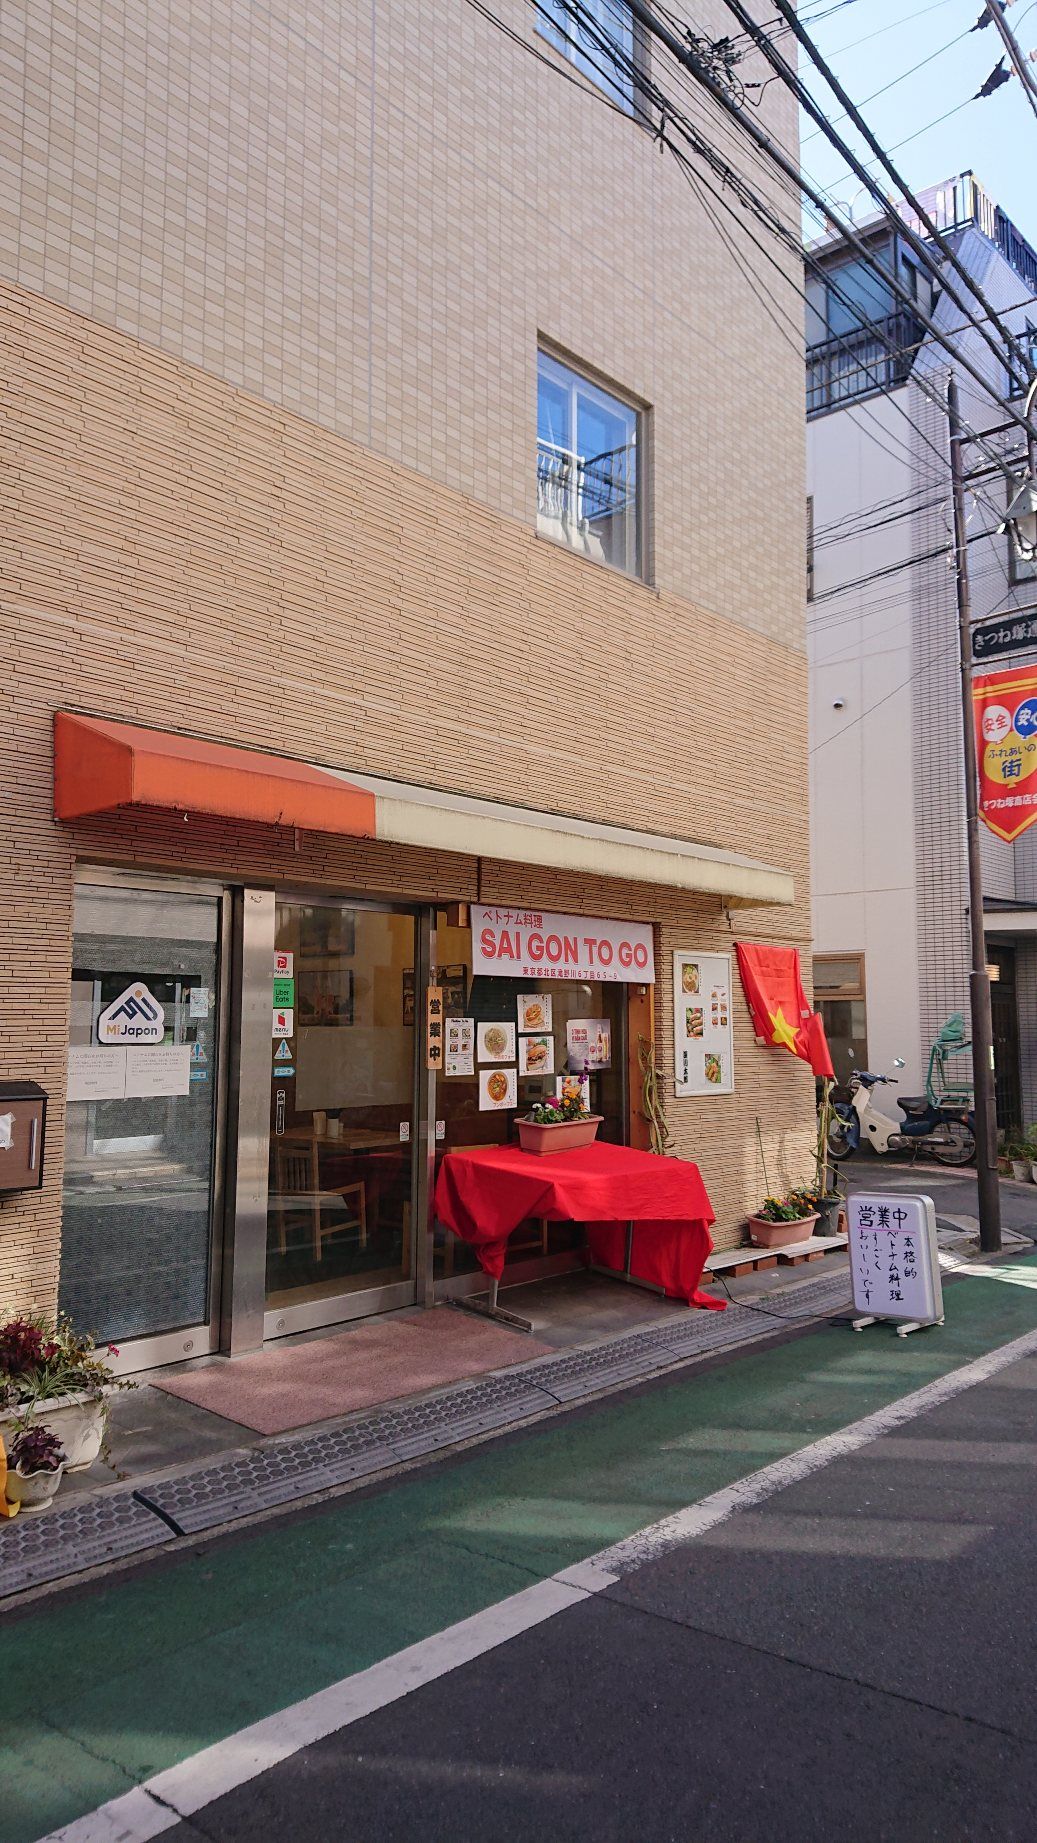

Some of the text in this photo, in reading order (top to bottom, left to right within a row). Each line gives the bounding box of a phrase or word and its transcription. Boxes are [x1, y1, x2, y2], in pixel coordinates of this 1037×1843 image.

[984, 713, 1008, 734] 安全
[988, 744, 1037, 758] ふれあいの
[1001, 758, 1022, 778] 街
[482, 909, 544, 929] ベトナム料理
[480, 928, 648, 969] SAI GON TO GO
[106, 1024, 158, 1038] MiJapon
[429, 998, 442, 1061] 営業中
[857, 1205, 908, 1230] 営業中
[859, 1229, 874, 1306] おいしいです
[886, 1231, 904, 1301] ベトナム料理
[903, 1235, 918, 1279] 本格的
